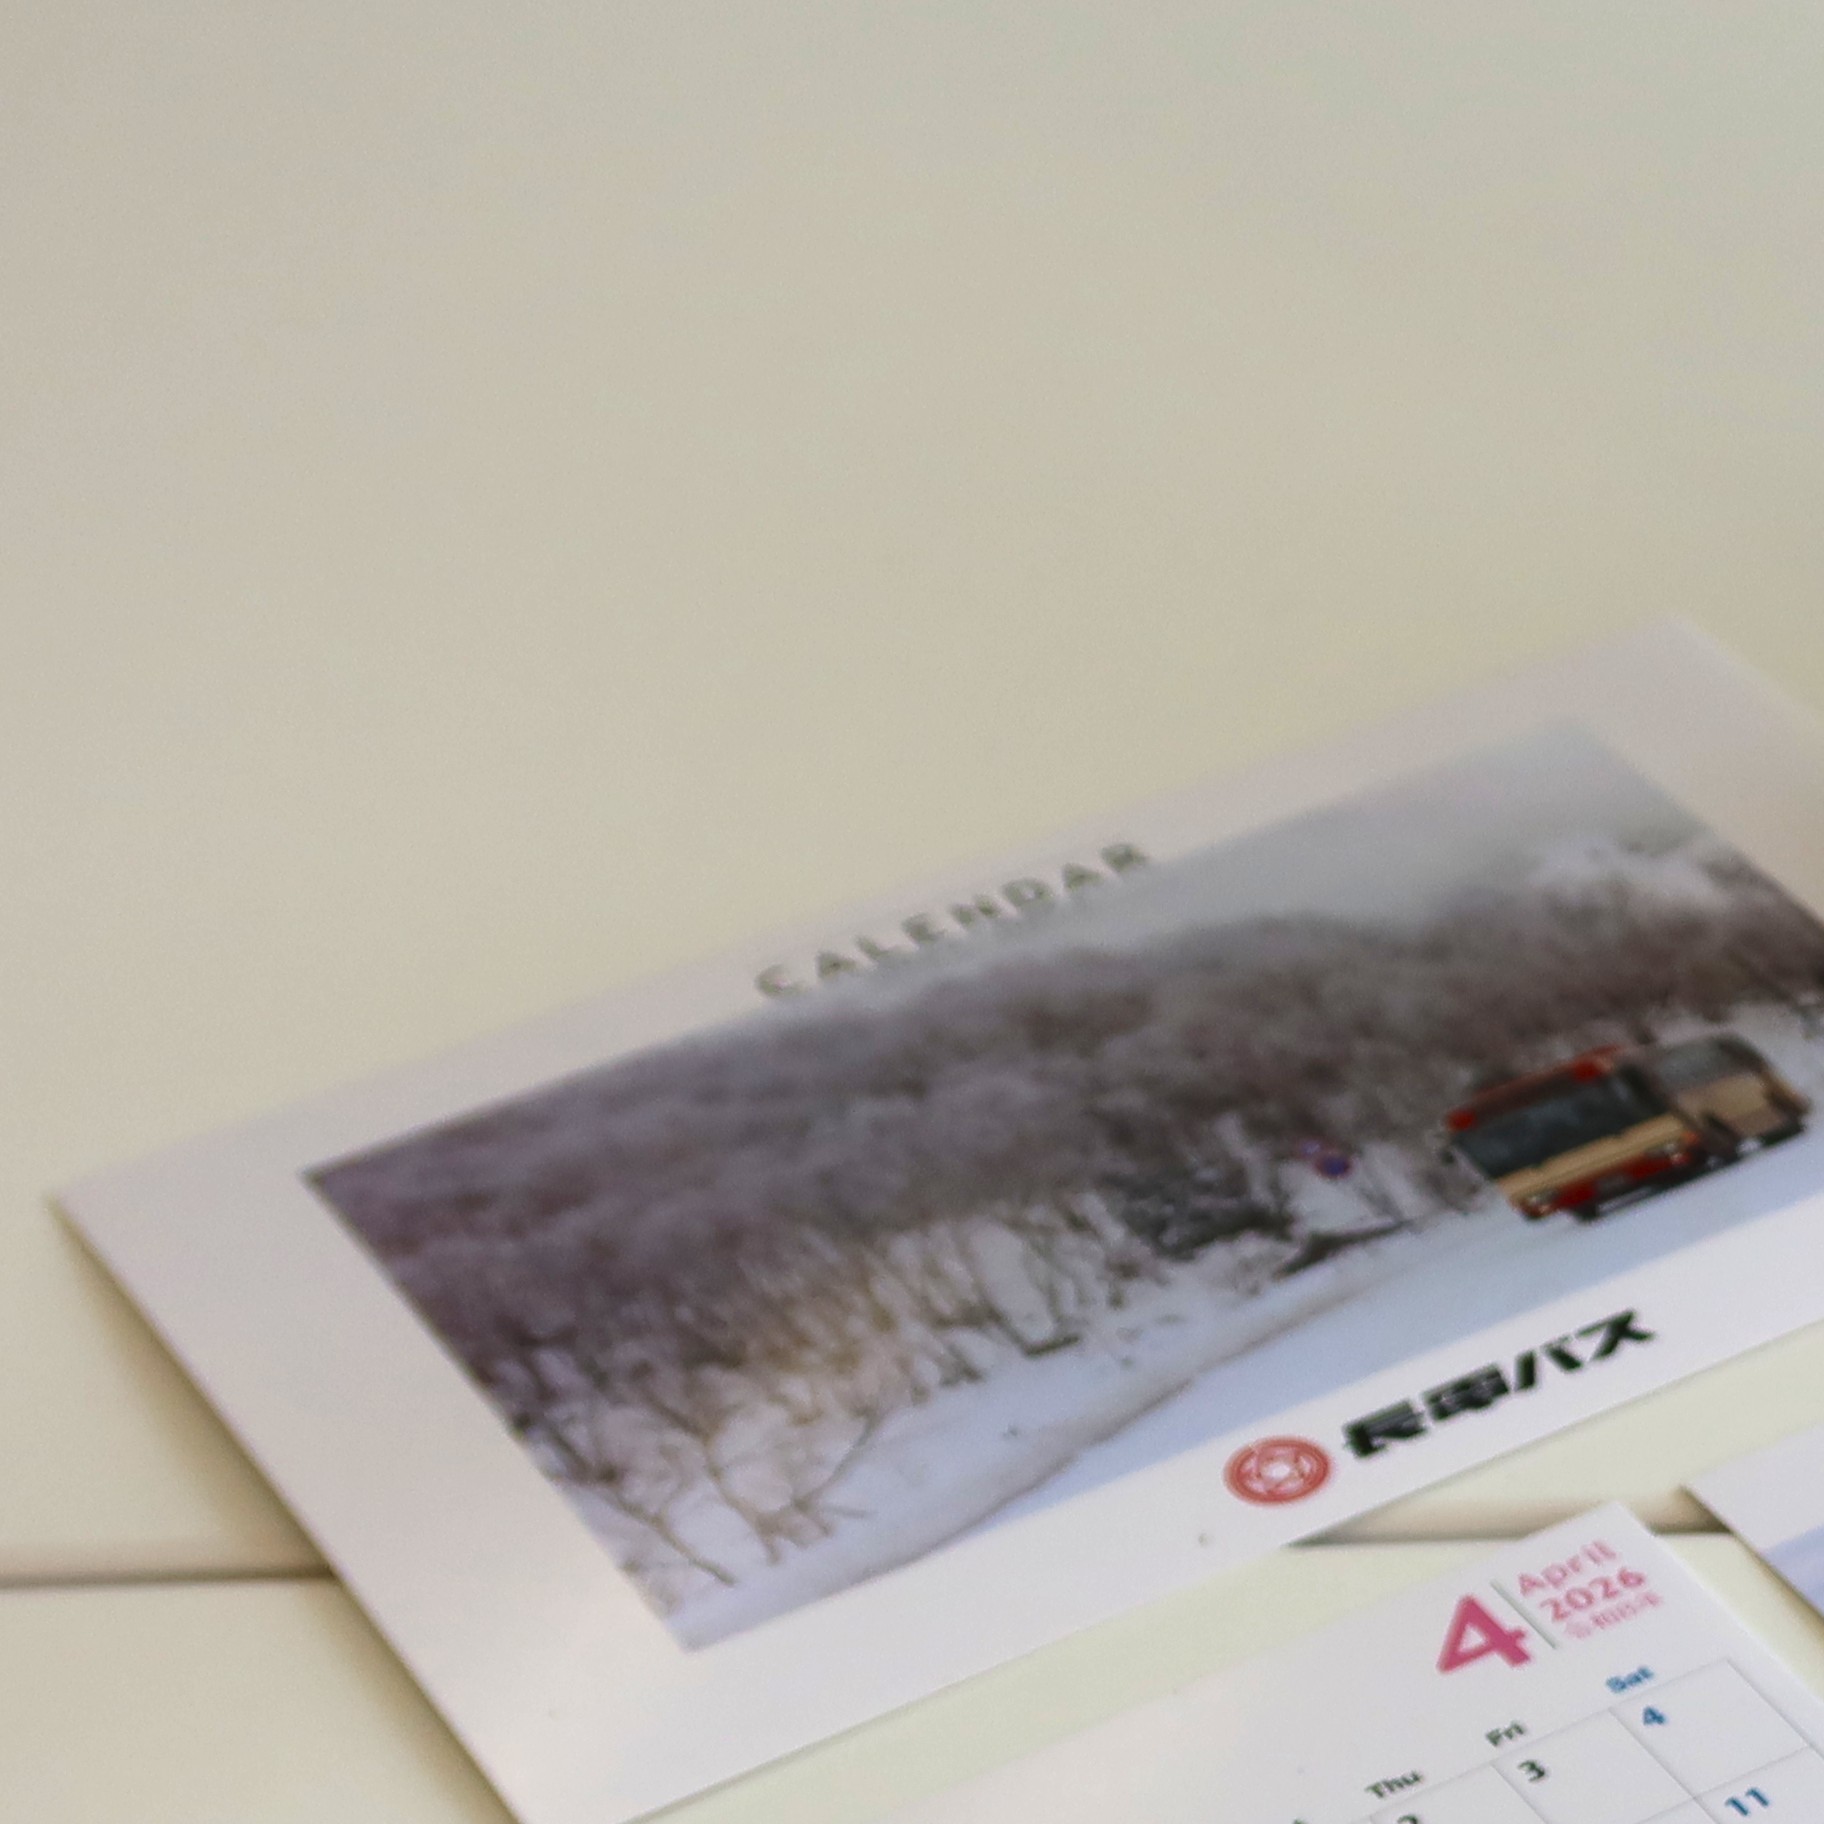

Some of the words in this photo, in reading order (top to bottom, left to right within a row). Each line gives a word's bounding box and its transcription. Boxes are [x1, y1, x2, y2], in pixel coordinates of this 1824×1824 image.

[754, 842, 1148, 998] CALENDAR
[1519, 1542, 1616, 1596] April
[1541, 1569, 1645, 1621] 2026
[1437, 1596, 1531, 1673] 4
